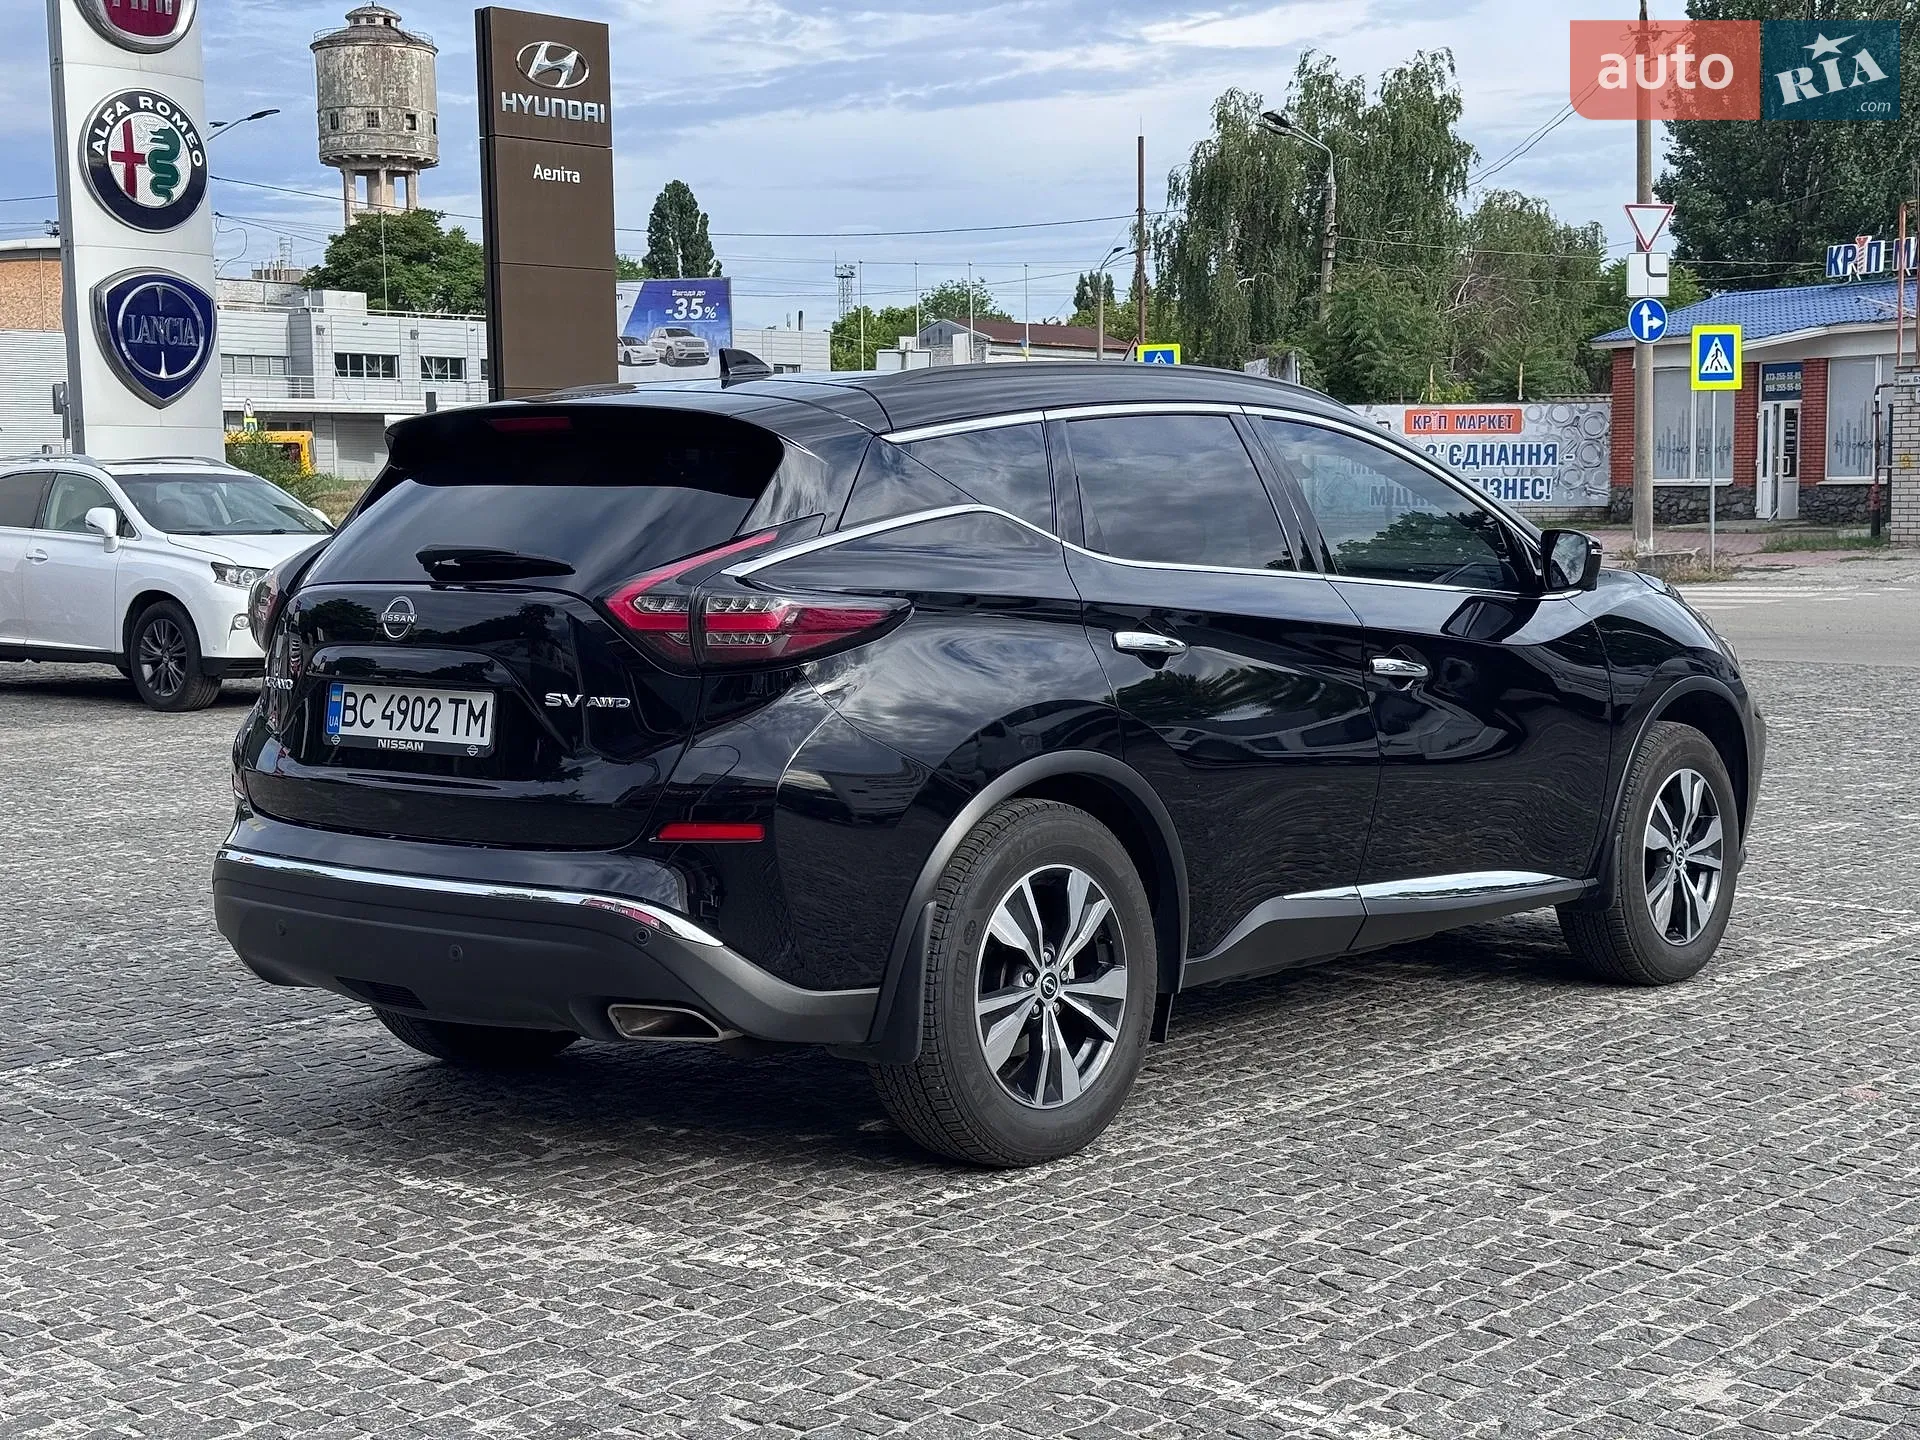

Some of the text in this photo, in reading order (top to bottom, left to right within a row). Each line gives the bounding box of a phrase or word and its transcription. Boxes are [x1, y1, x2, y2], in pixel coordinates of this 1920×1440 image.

[501, 91, 606, 123] HYUNDAI
[92, 95, 203, 167] ALFA ROMEO
[533, 163, 581, 184] Аеліта
[127, 314, 199, 346] LANCIA
[1455, 413, 1514, 431] МАРКЕТ
[1471, 477, 1552, 500] ІЗНЕС!
[382, 613, 416, 623] NISSAN
[545, 692, 631, 709] SV AWD
[328, 716, 339, 727] UA
[341, 691, 488, 738] BC 4902 TM
[377, 738, 424, 751] NISSAN
